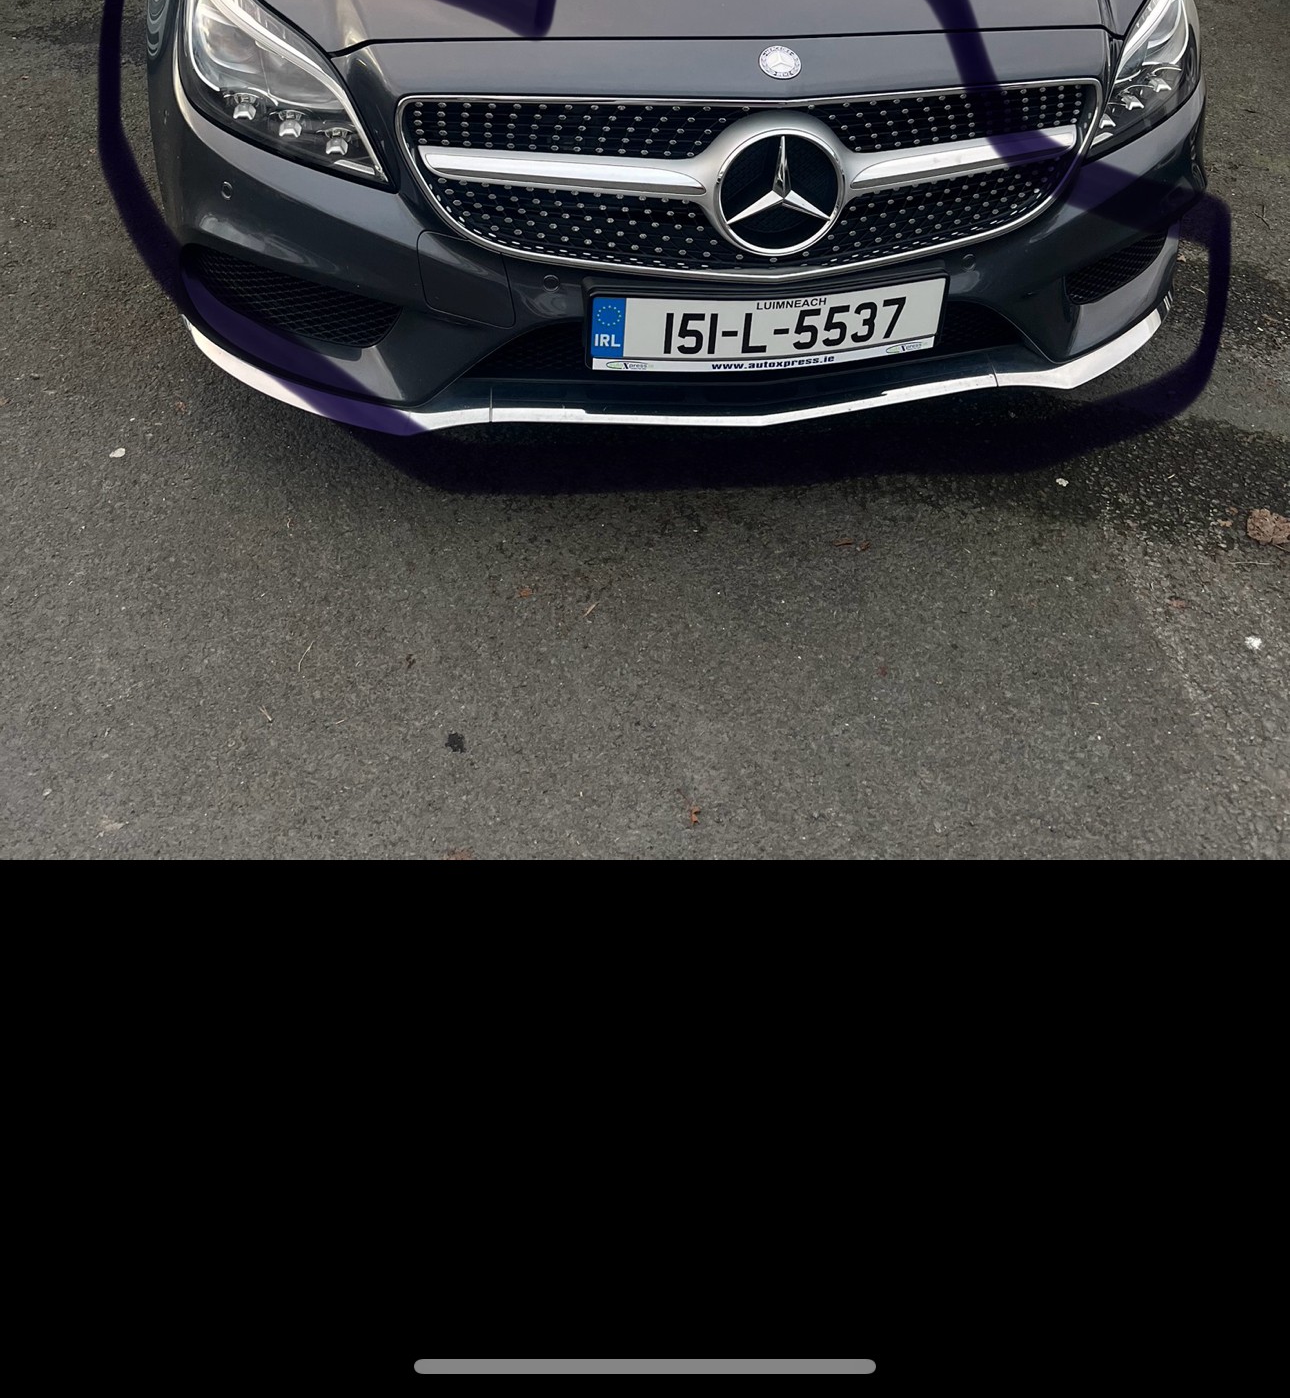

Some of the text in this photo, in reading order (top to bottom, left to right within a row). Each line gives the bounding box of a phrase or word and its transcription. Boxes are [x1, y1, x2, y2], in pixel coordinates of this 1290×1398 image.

[756, 298, 827, 310] LUIMNEACH
[594, 333, 621, 348] IRL
[711, 355, 835, 370] www.autoxpress.ie
